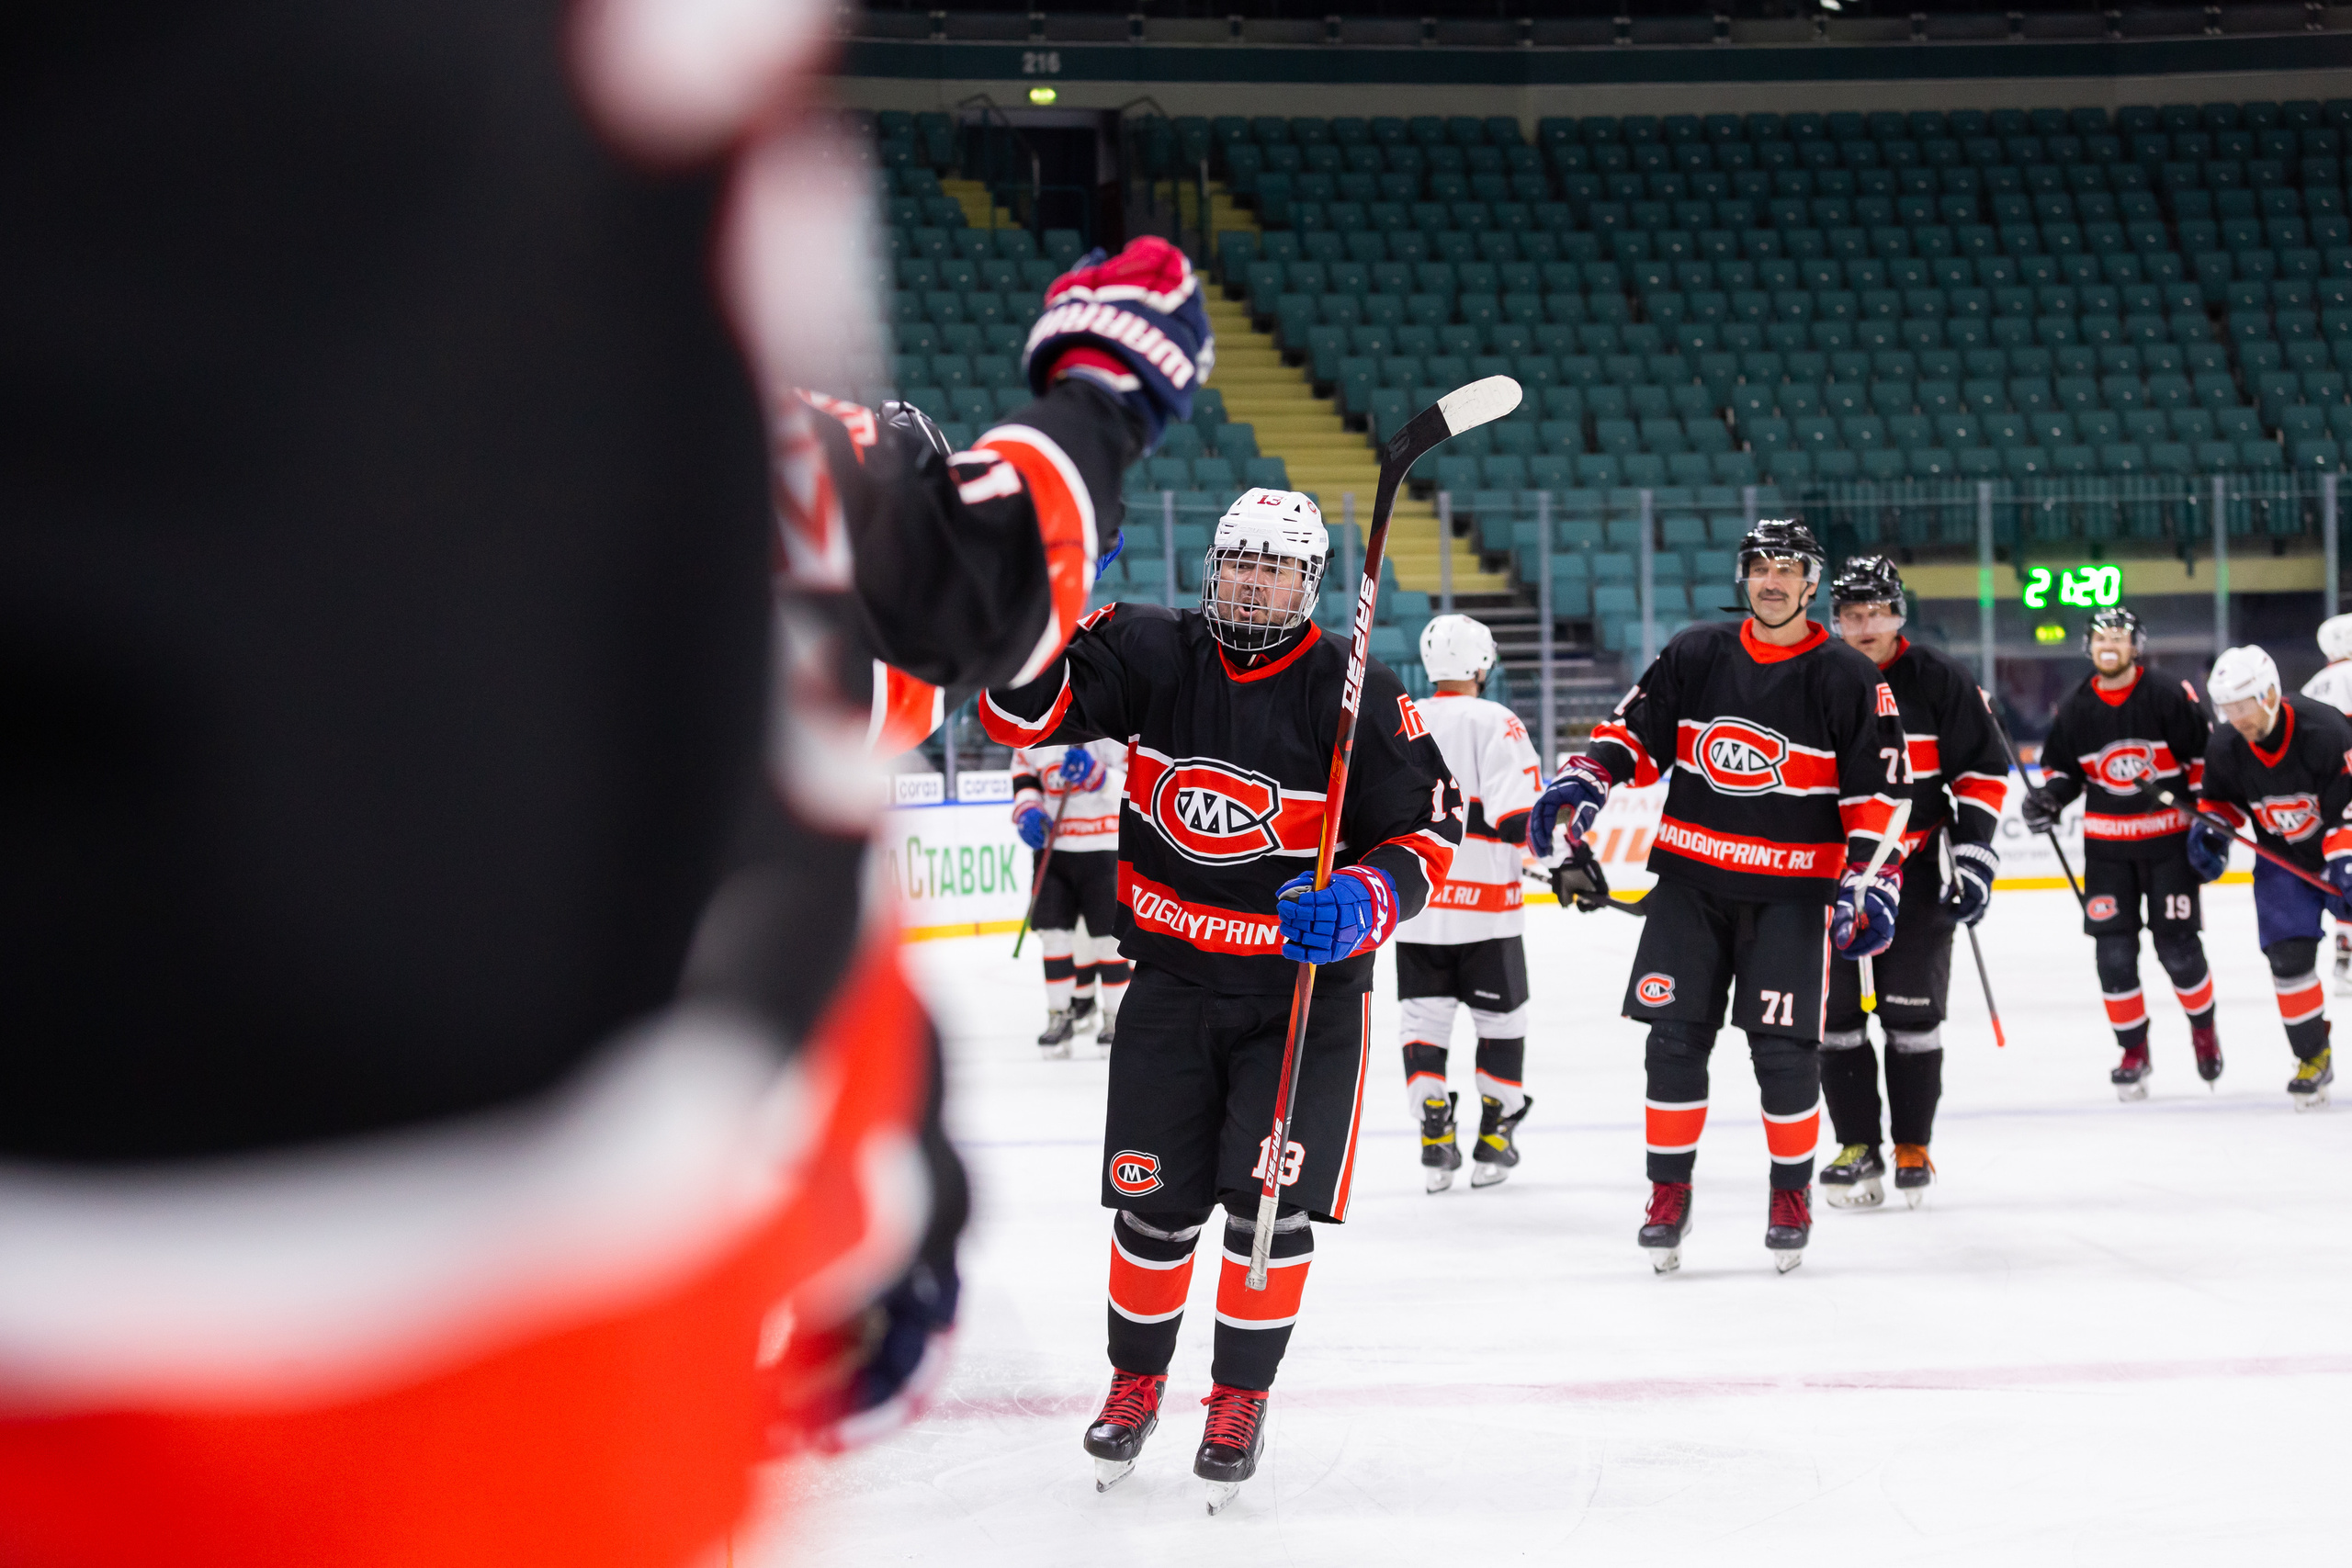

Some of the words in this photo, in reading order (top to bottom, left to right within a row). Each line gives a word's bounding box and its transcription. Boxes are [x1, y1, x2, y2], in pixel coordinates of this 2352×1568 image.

[1257, 494, 1284, 506] 13
[1880, 748, 1914, 784] 71
[2165, 894, 2192, 919] 19
[1760, 989, 1793, 1026] 71
